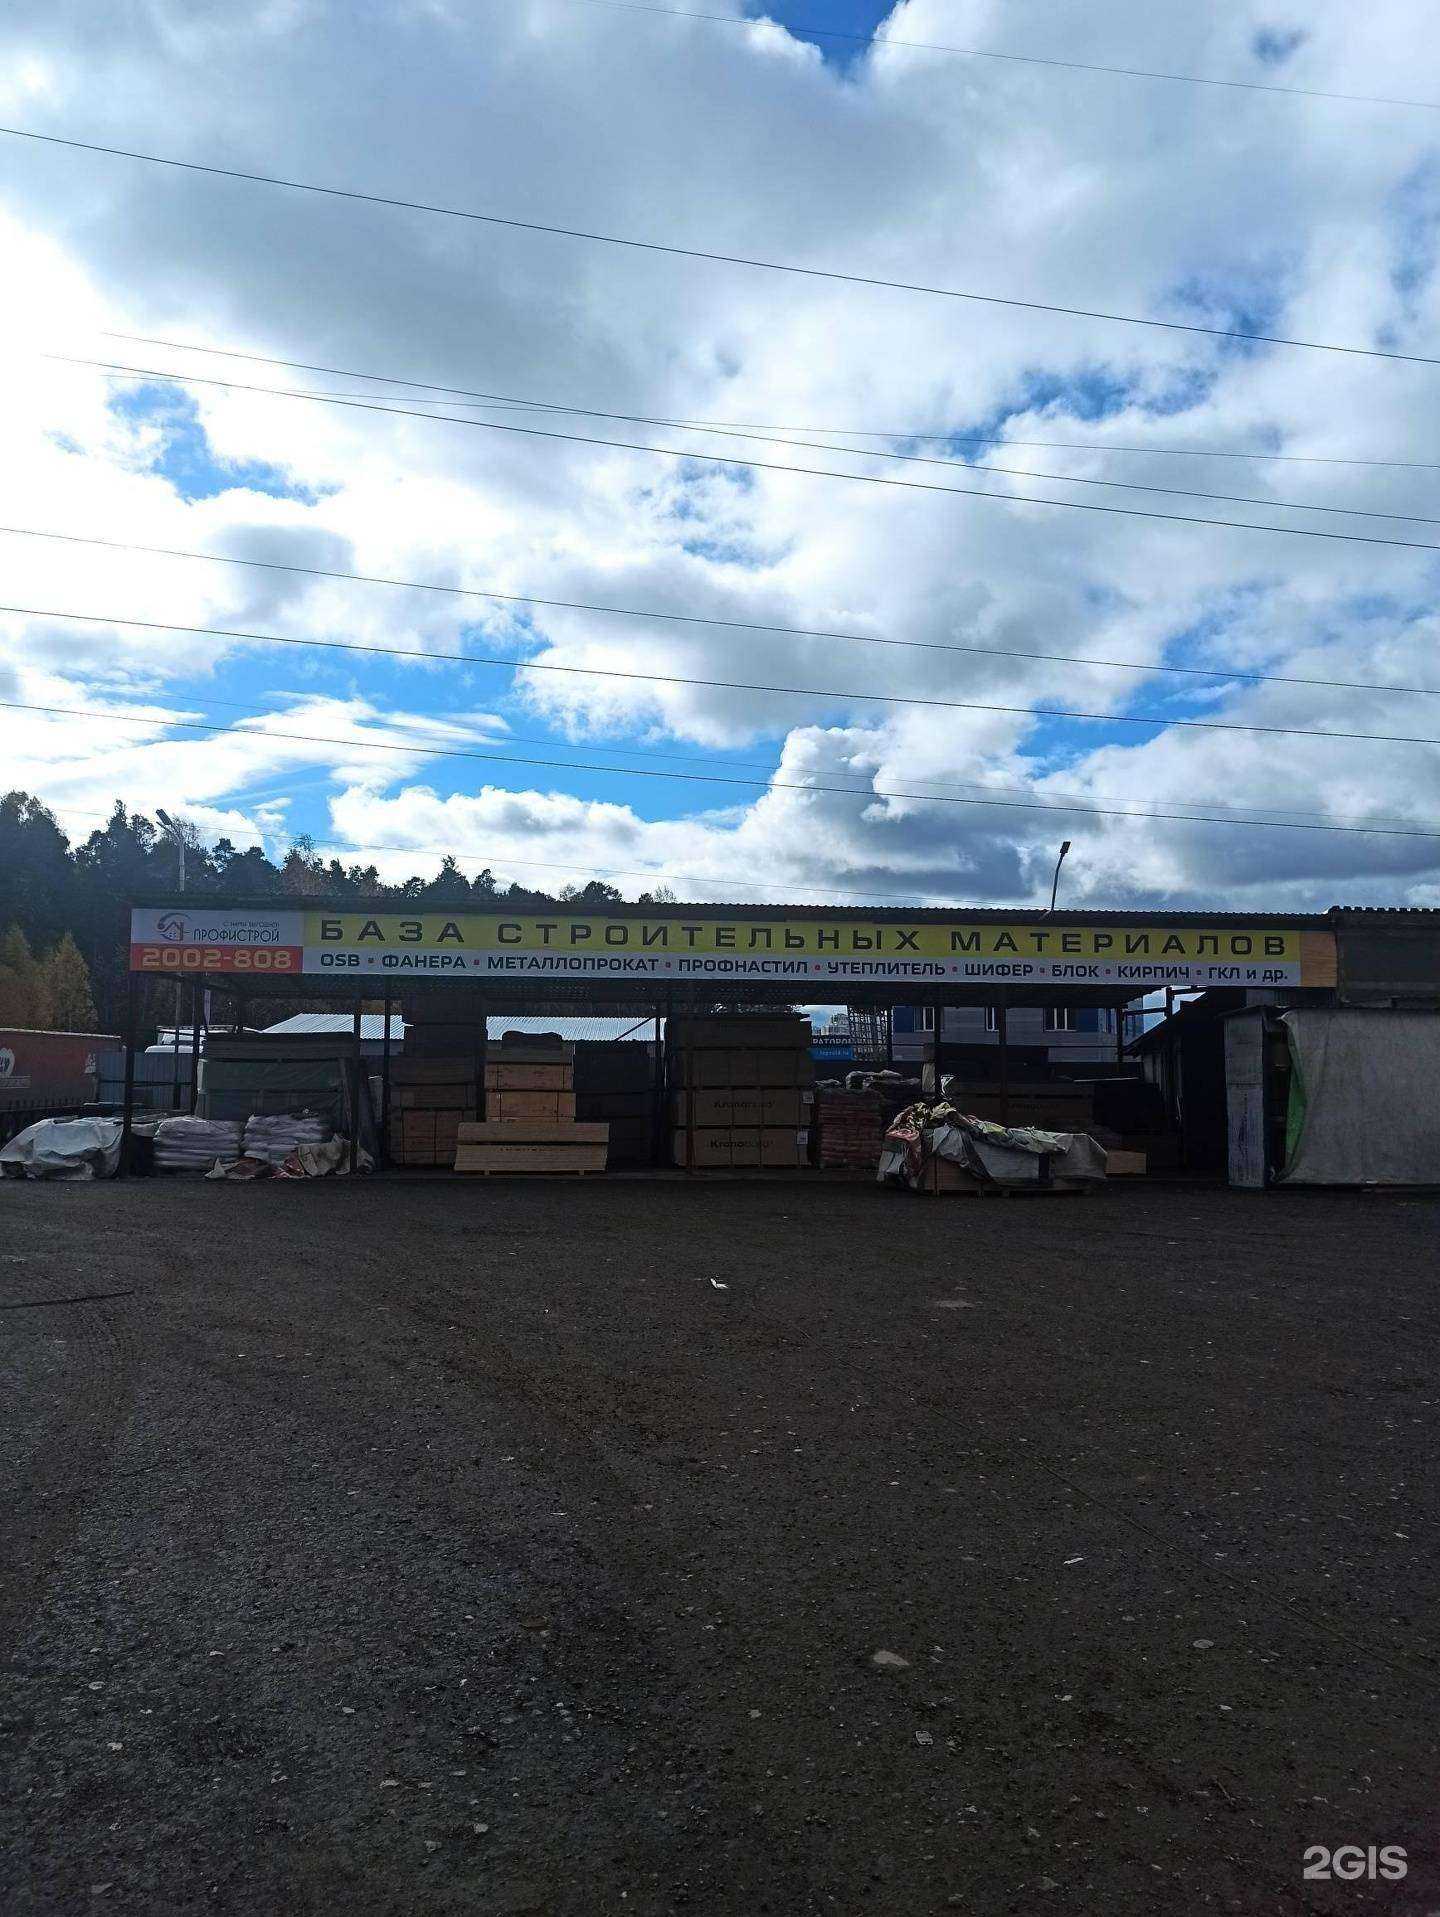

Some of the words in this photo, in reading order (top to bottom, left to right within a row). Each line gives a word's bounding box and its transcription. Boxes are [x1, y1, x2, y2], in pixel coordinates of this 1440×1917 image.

[193, 928, 280, 943] ПРОФИСТРОЙ
[321, 919, 465, 943] БАЗА
[497, 923, 920, 951] СТРОИТЕЛЬНЫХ
[951, 931, 1285, 956] МАТЕРИАЛОВ
[142, 947, 292, 969] 2002-808
[320, 953, 360, 968] OSB
[382, 953, 466, 970] ФАНЕРА
[487, 956, 657, 972] МЕТАЛЛОПРОКАТ
[678, 959, 808, 975] ПРОФНАСТИЛ
[827, 961, 946, 977] УТЕПЛИТЕЛЬ
[964, 964, 1034, 978] ШИФЕР
[1051, 964, 1100, 979] БЛОК
[1117, 966, 1190, 979] КИРПИЧ
[1208, 967, 1241, 981] ГКЛ
[1246, 970, 1258, 981] и
[1262, 969, 1289, 984] др.
